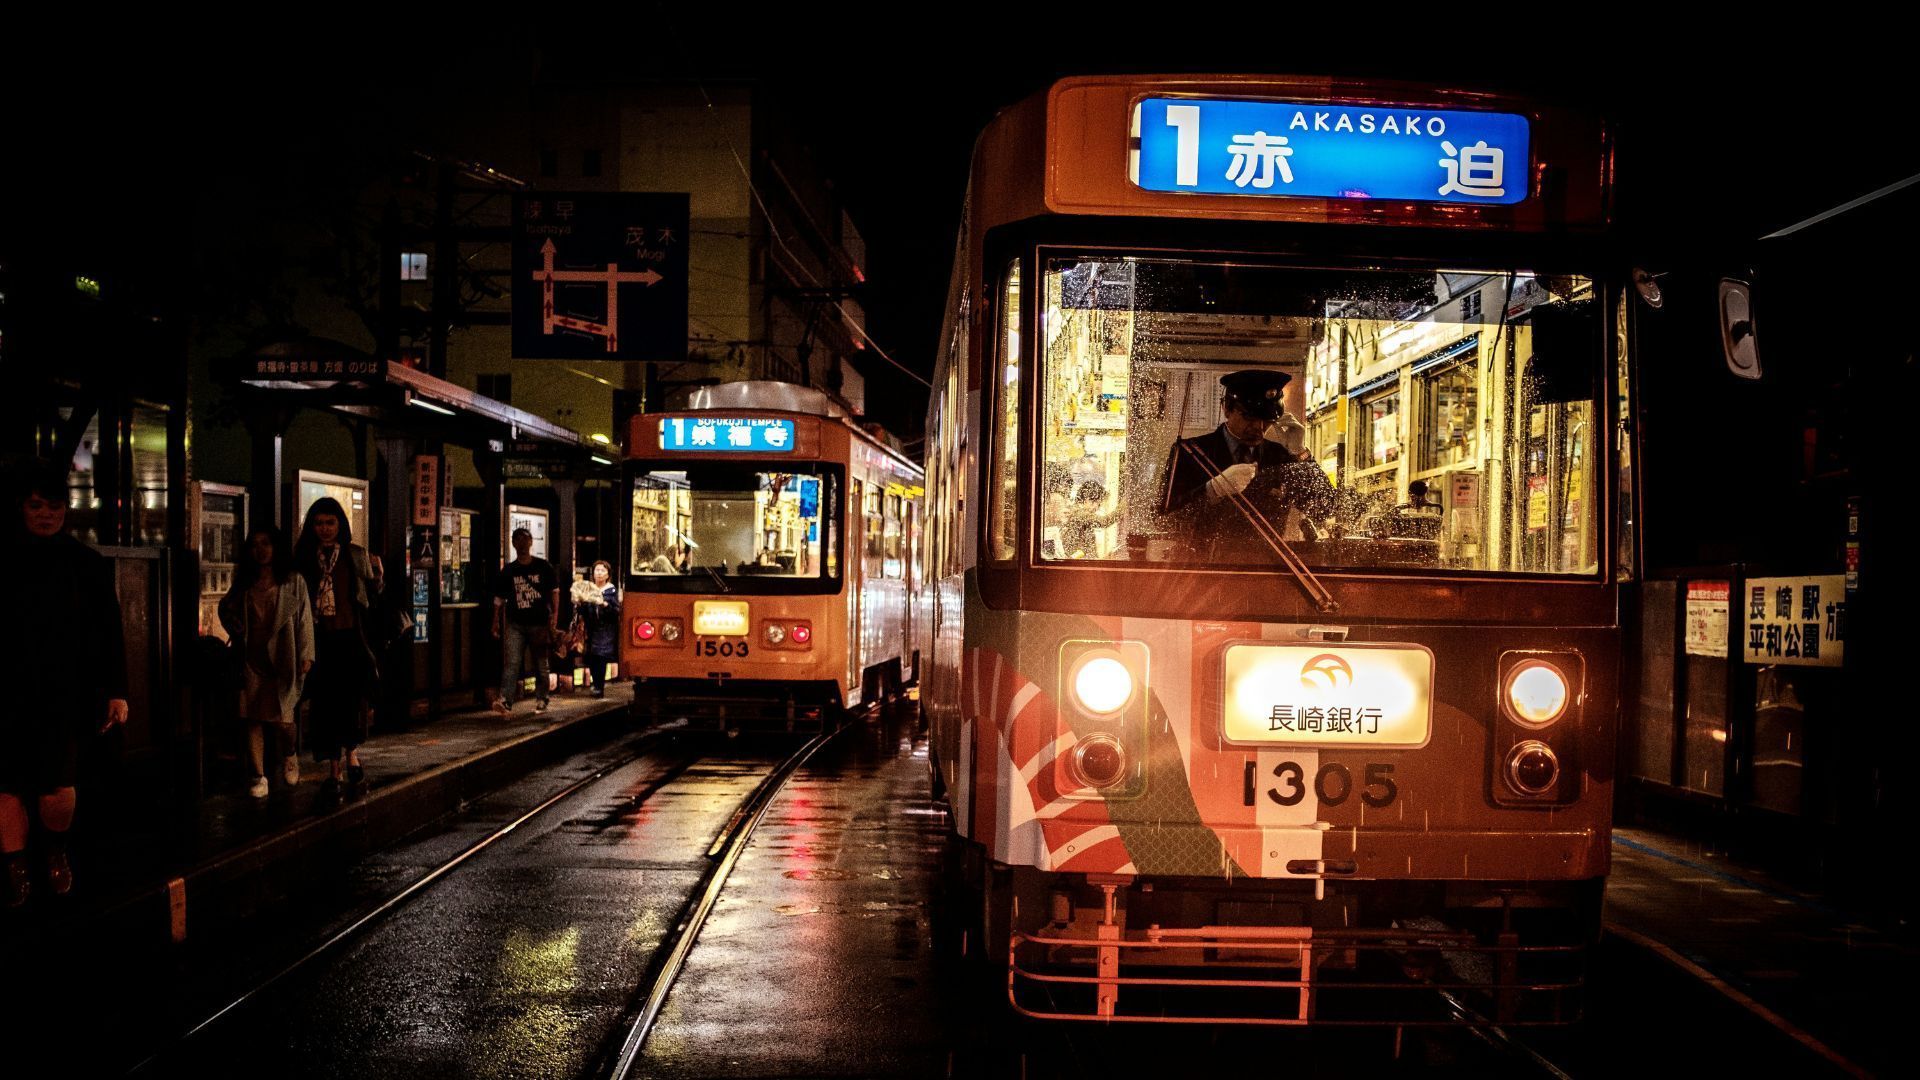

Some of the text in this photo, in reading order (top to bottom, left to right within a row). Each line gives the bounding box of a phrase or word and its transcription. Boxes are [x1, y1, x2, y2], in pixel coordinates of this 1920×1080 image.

[1289, 111, 1447, 138] AKASAKO
[1166, 104, 1506, 198] 1 赤迫
[624, 225, 679, 246] 茂木
[636, 248, 666, 261] Mogi
[348, 360, 378, 373] のりば
[671, 418, 685, 446] 1
[747, 418, 783, 427] TEMPLE
[1750, 585, 1820, 620] 長崎駅
[696, 641, 749, 657] 1503
[1749, 623, 1820, 659] 平和公園
[1268, 704, 1383, 734] 長崎銀行
[1243, 760, 1398, 808] 1305
